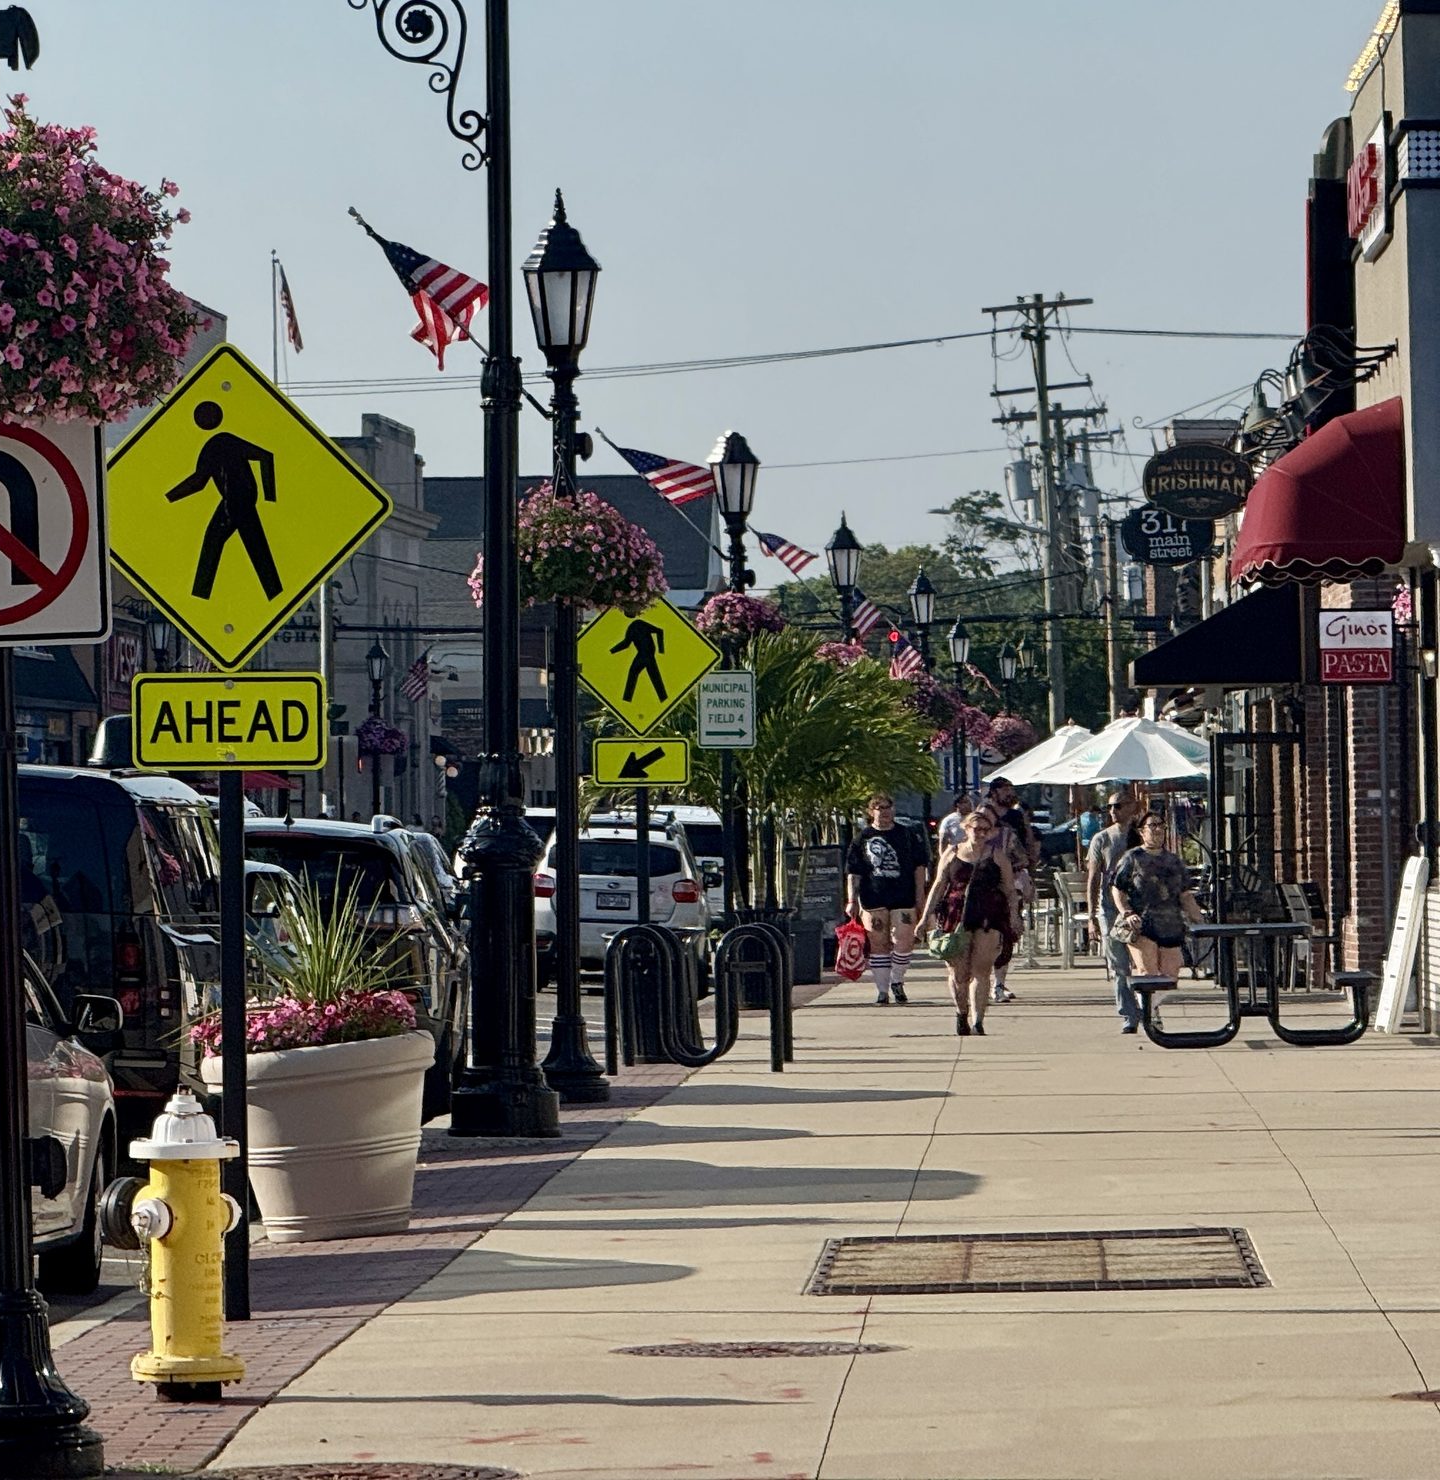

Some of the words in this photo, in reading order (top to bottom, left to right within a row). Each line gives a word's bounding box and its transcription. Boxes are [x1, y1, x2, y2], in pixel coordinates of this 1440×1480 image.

[1150, 473, 1246, 497] IRISHMAN
[1149, 533, 1191, 547] main
[1150, 546, 1192, 559] street
[1326, 615, 1387, 644] Gino's
[1325, 653, 1388, 674] PASTA
[702, 682, 749, 693] MUNICIPAL
[707, 698, 745, 709] PARKING
[150, 699, 310, 744] AHEAD
[708, 713, 734, 724] FIELD
[737, 713, 744, 724] 4
